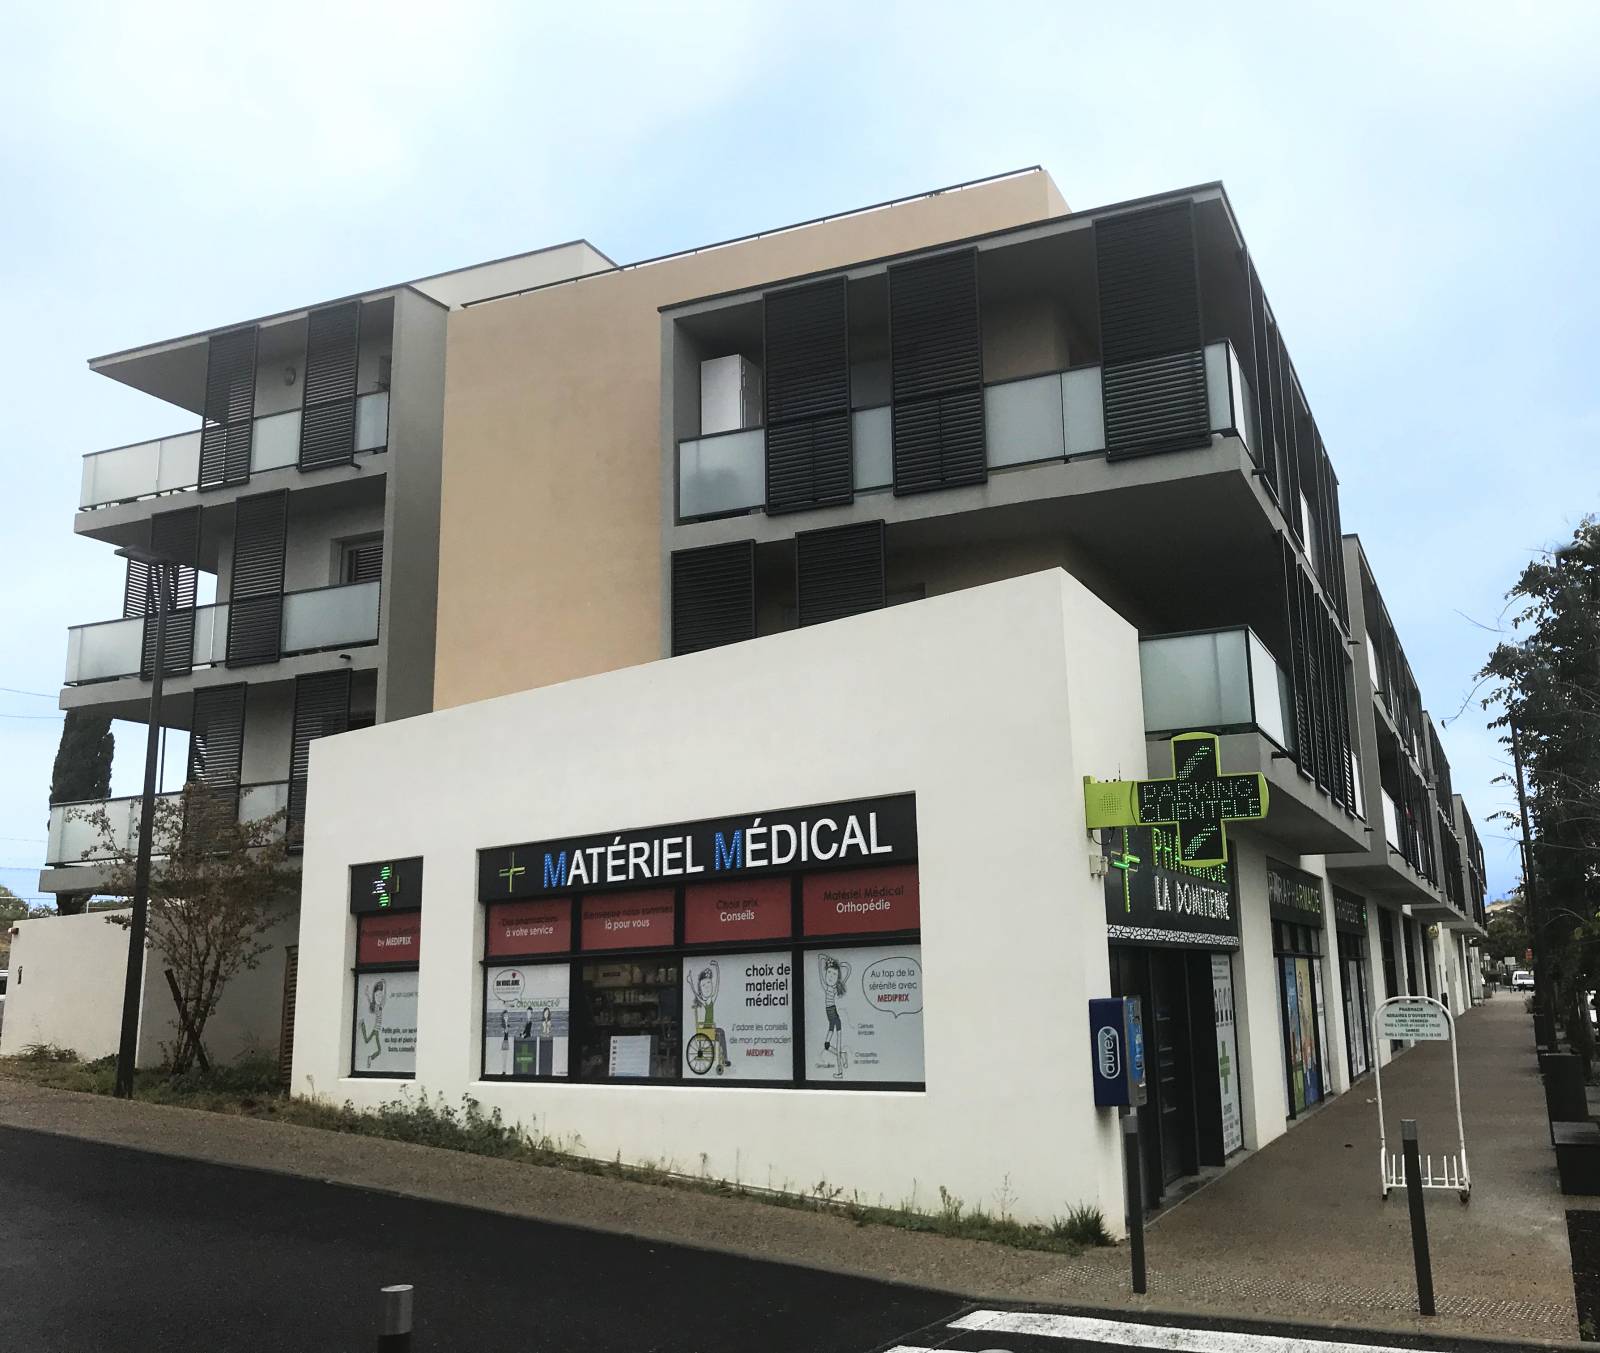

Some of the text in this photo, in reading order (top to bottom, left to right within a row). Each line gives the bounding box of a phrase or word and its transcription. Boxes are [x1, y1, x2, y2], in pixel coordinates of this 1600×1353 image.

[1143, 779, 1253, 802] PARKING
[1140, 798, 1261, 822] CLIENTELE
[543, 811, 893, 889] MATÉRIEL MÉDICAL
[1154, 875, 1172, 912] LA
[836, 898, 891, 914] Orthopédie
[719, 910, 755, 922] Conseils
[613, 920, 630, 931] pour
[632, 919, 650, 929] vous
[505, 926, 554, 937] à votre service
[385, 935, 412, 947] MEDIPRIX
[745, 963, 791, 977] choix de
[870, 968, 915, 980] Au top de la
[745, 977, 789, 992] materiel
[898, 981, 917, 990] avec
[745, 992, 789, 1007] médical
[877, 994, 909, 1003] MEDIPRIX
[755, 1023, 763, 1031] les
[764, 1022, 788, 1031] conseils
[729, 1036, 791, 1046] de mon pharmacien
[745, 1048, 775, 1057] MEDIPRIX
[1103, 1031, 1116, 1074] durex
